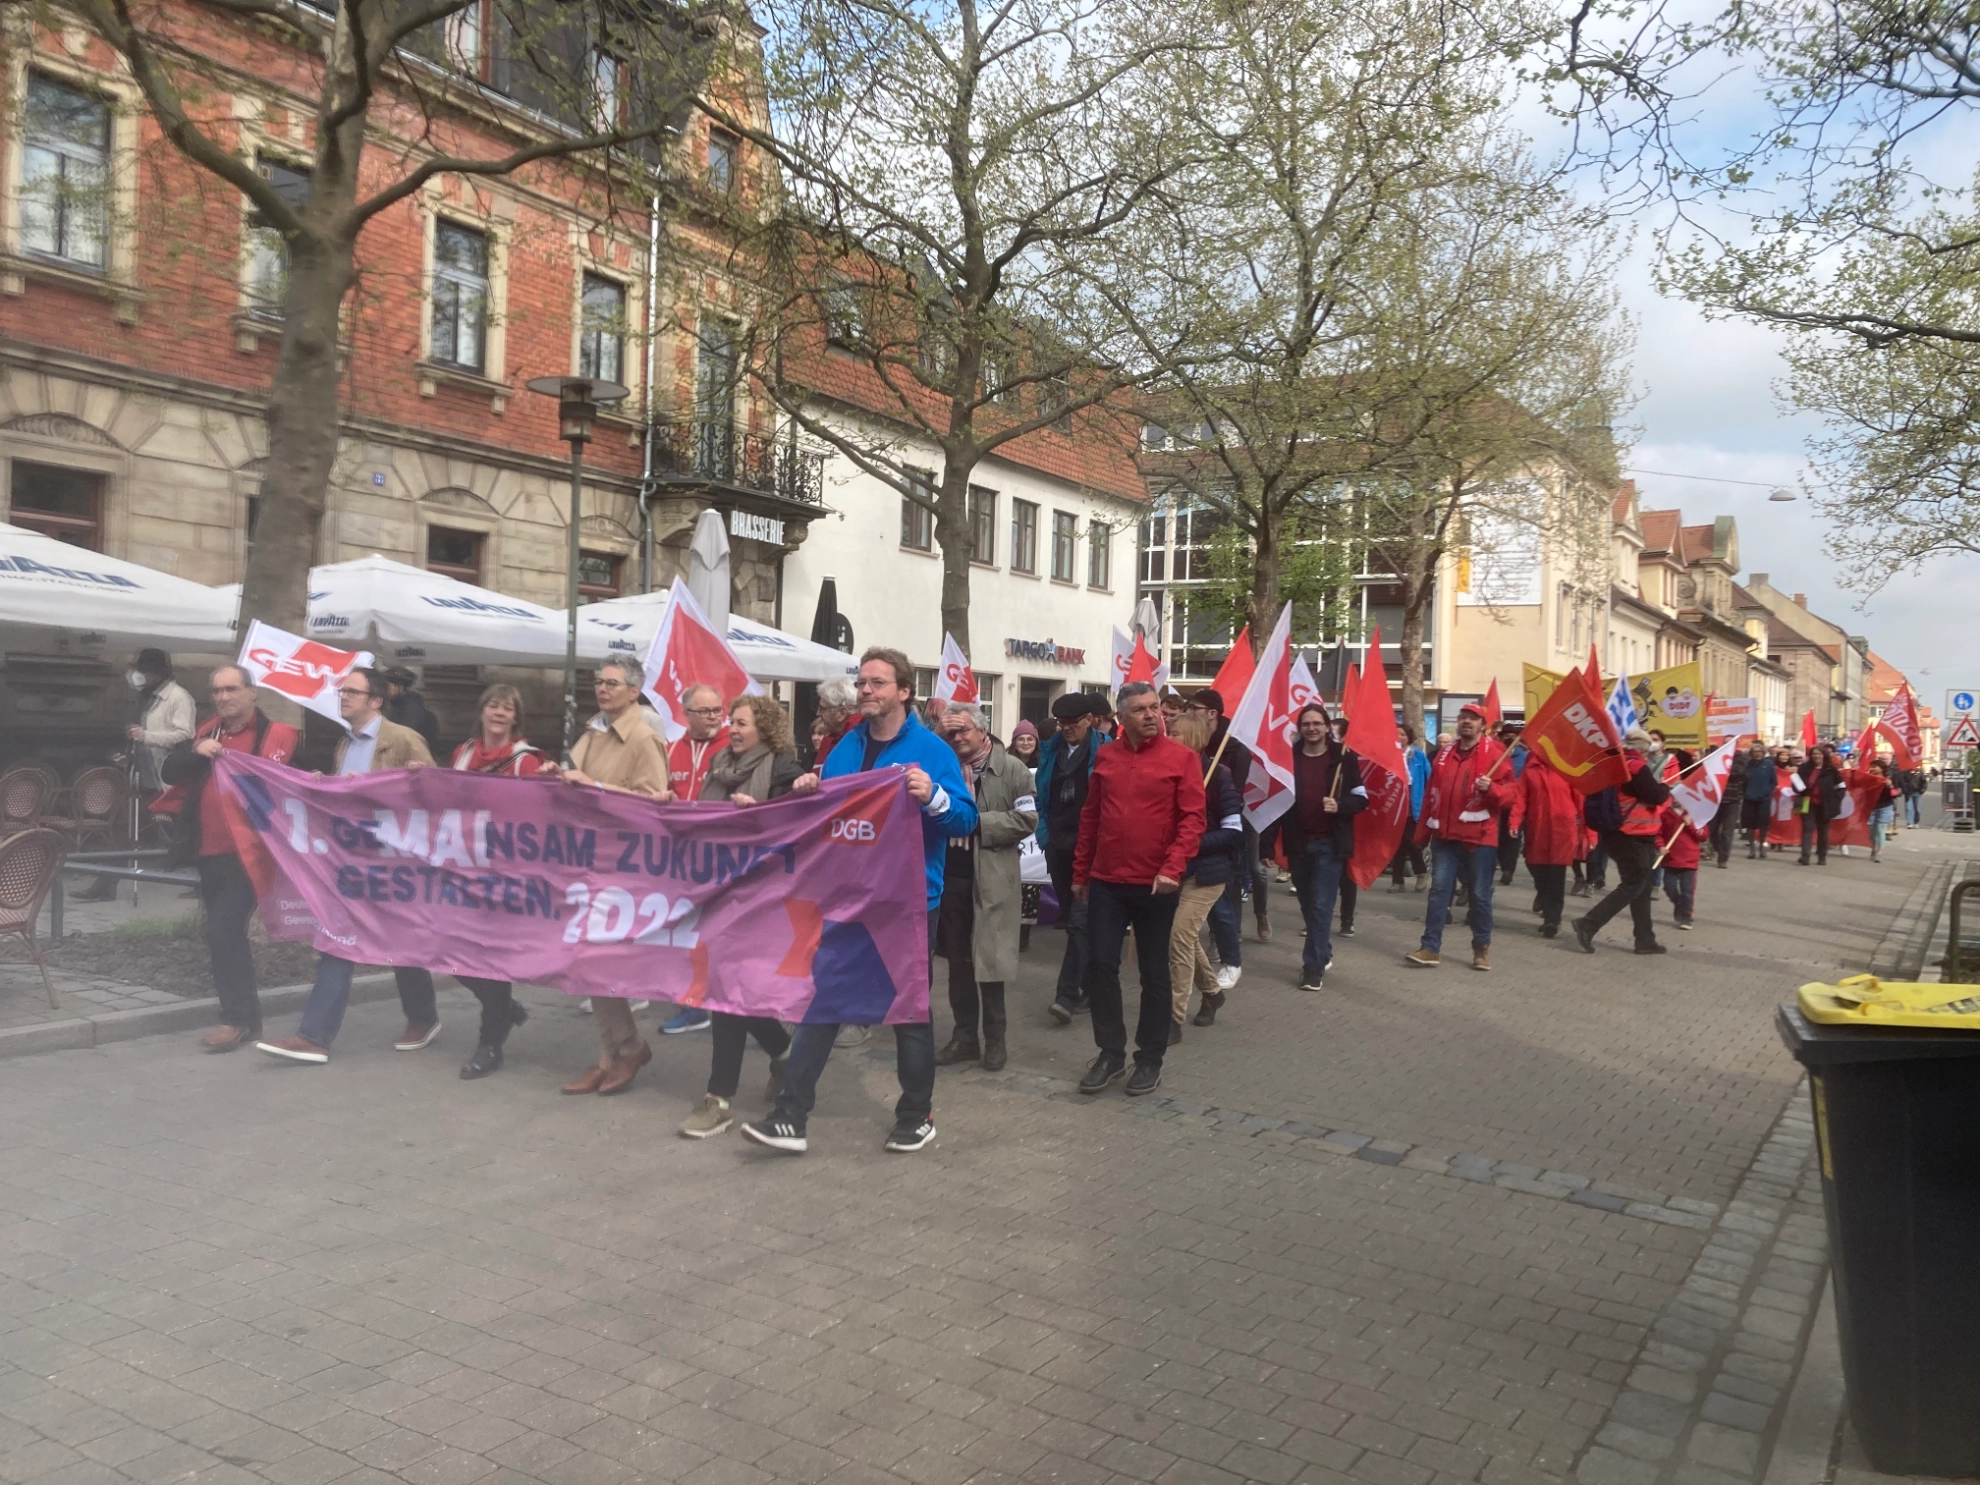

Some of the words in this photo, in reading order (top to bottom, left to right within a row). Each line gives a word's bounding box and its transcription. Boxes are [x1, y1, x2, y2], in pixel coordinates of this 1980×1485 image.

[731, 510, 785, 546] BRASSERIE
[0, 555, 147, 589] VAZZA
[249, 648, 347, 688] GEW
[1563, 702, 1609, 749] DKP
[1882, 711, 1923, 758] JUSOS
[283, 798, 329, 855] 1.
[831, 818, 875, 841] DGB
[335, 864, 561, 921] GESTALTEN.
[563, 882, 701, 949] 2022
